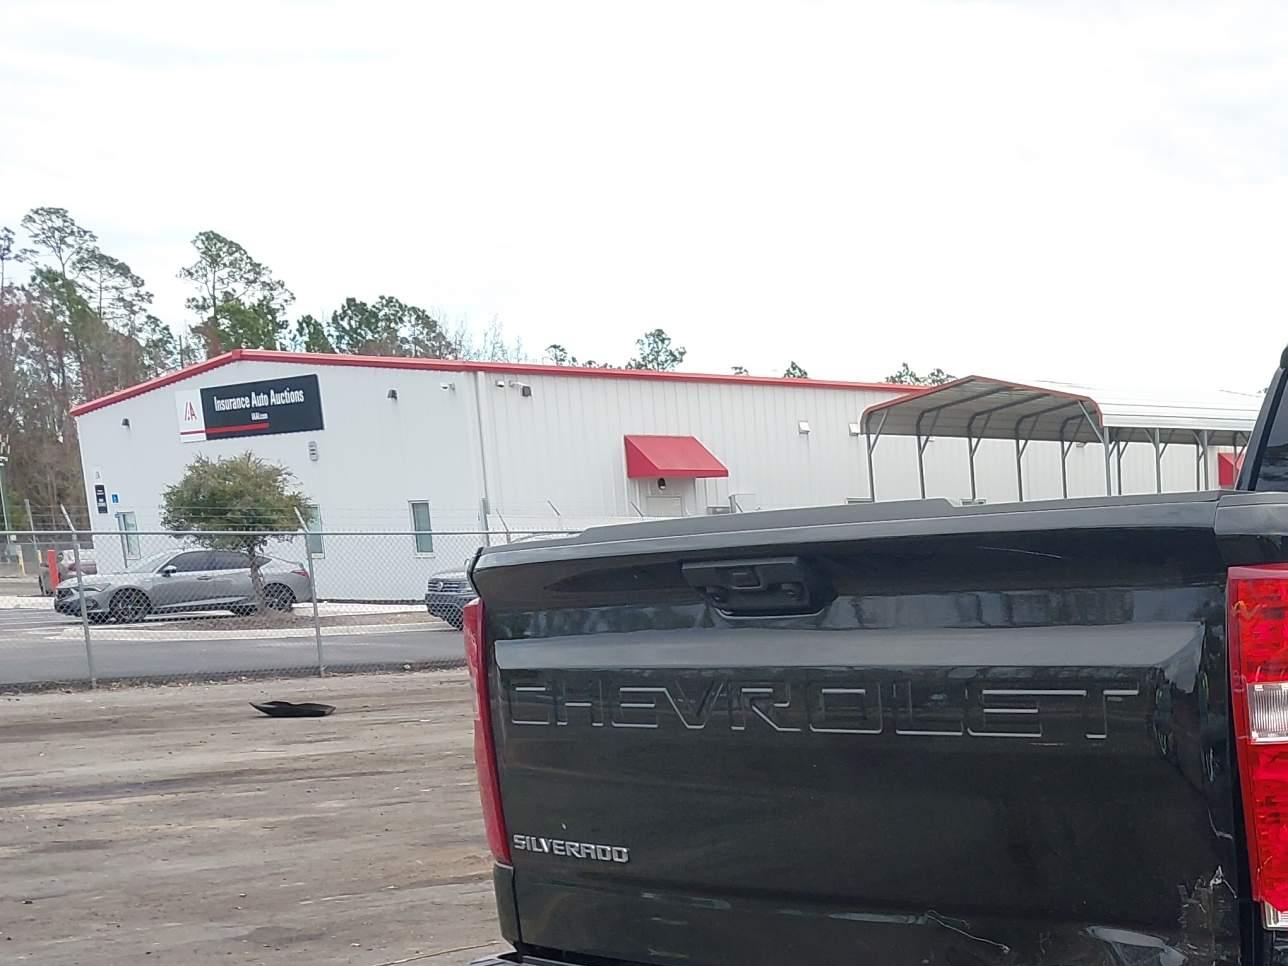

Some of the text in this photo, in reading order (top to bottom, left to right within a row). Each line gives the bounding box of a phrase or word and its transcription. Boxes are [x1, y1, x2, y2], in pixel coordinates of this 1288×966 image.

[214, 387, 305, 412] Insurance Auto Auctions
[511, 681, 1142, 741] CHEVROLET
[513, 834, 630, 864] SILVERADO
